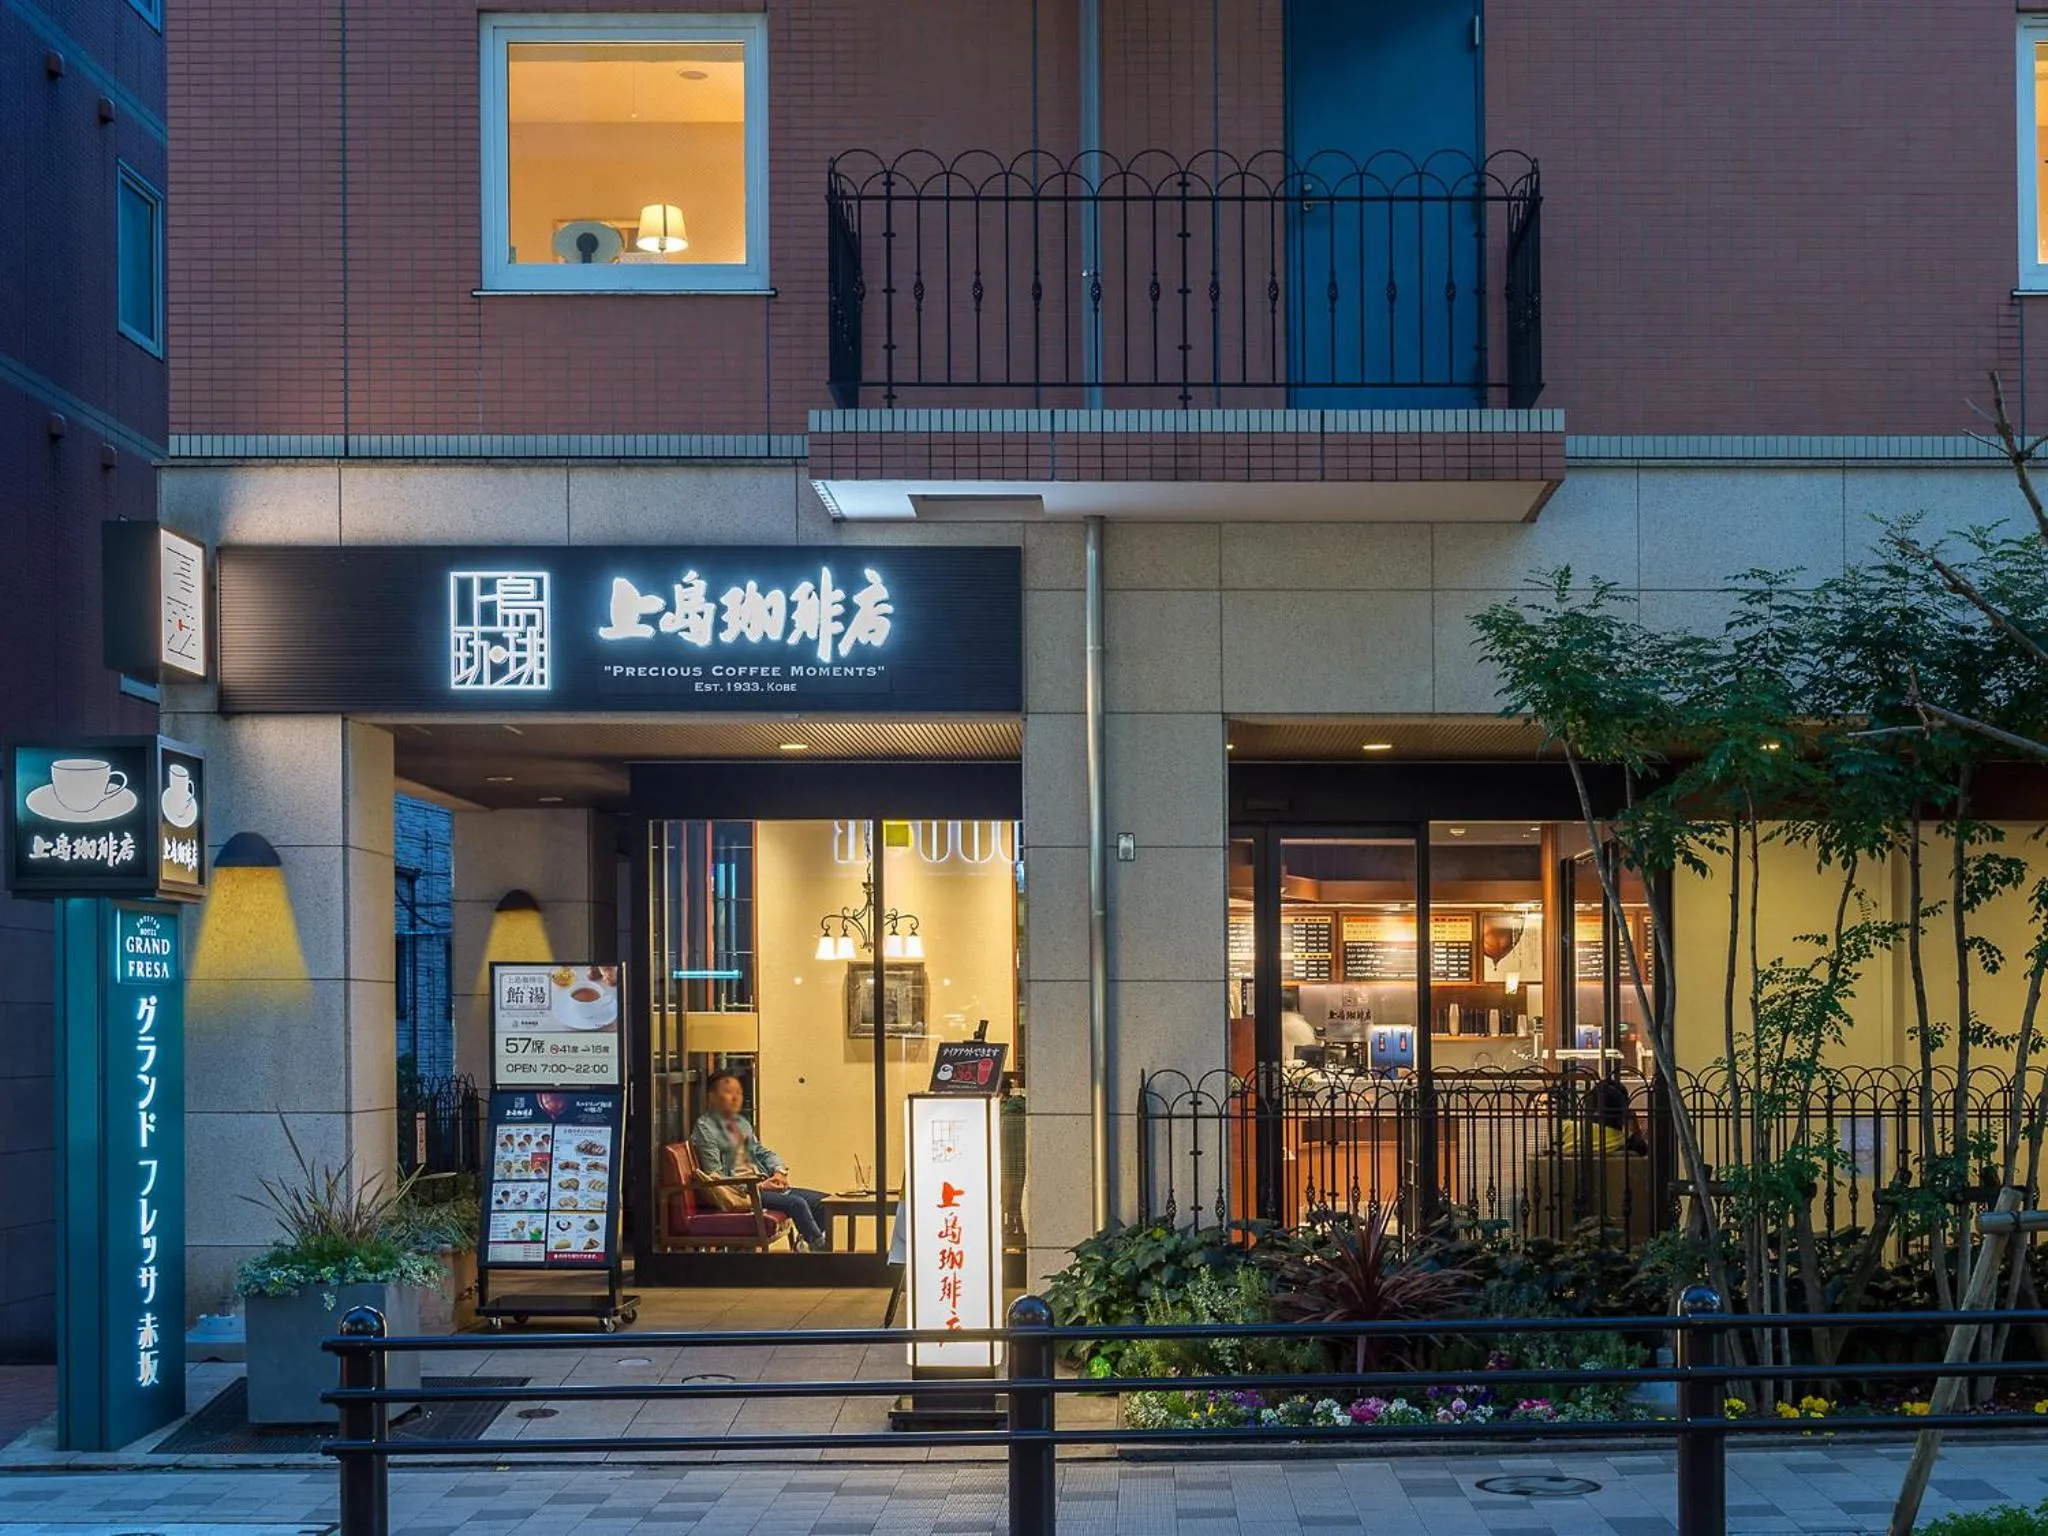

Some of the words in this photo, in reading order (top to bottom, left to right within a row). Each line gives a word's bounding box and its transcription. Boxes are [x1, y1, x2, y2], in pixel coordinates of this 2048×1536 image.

[597, 566, 895, 663] 上島珈琲店
[711, 665, 781, 677] COFFEE
[28, 831, 136, 868] 上島珈琲店
[126, 936, 171, 956] GRAND
[127, 960, 170, 979] FRESA
[505, 1037, 545, 1055] 57席
[136, 994, 159, 1148] グランド
[506, 1063, 538, 1074] OPEN
[136, 1159, 159, 1304] フレッサ
[136, 1312, 159, 1387] 赤坂
